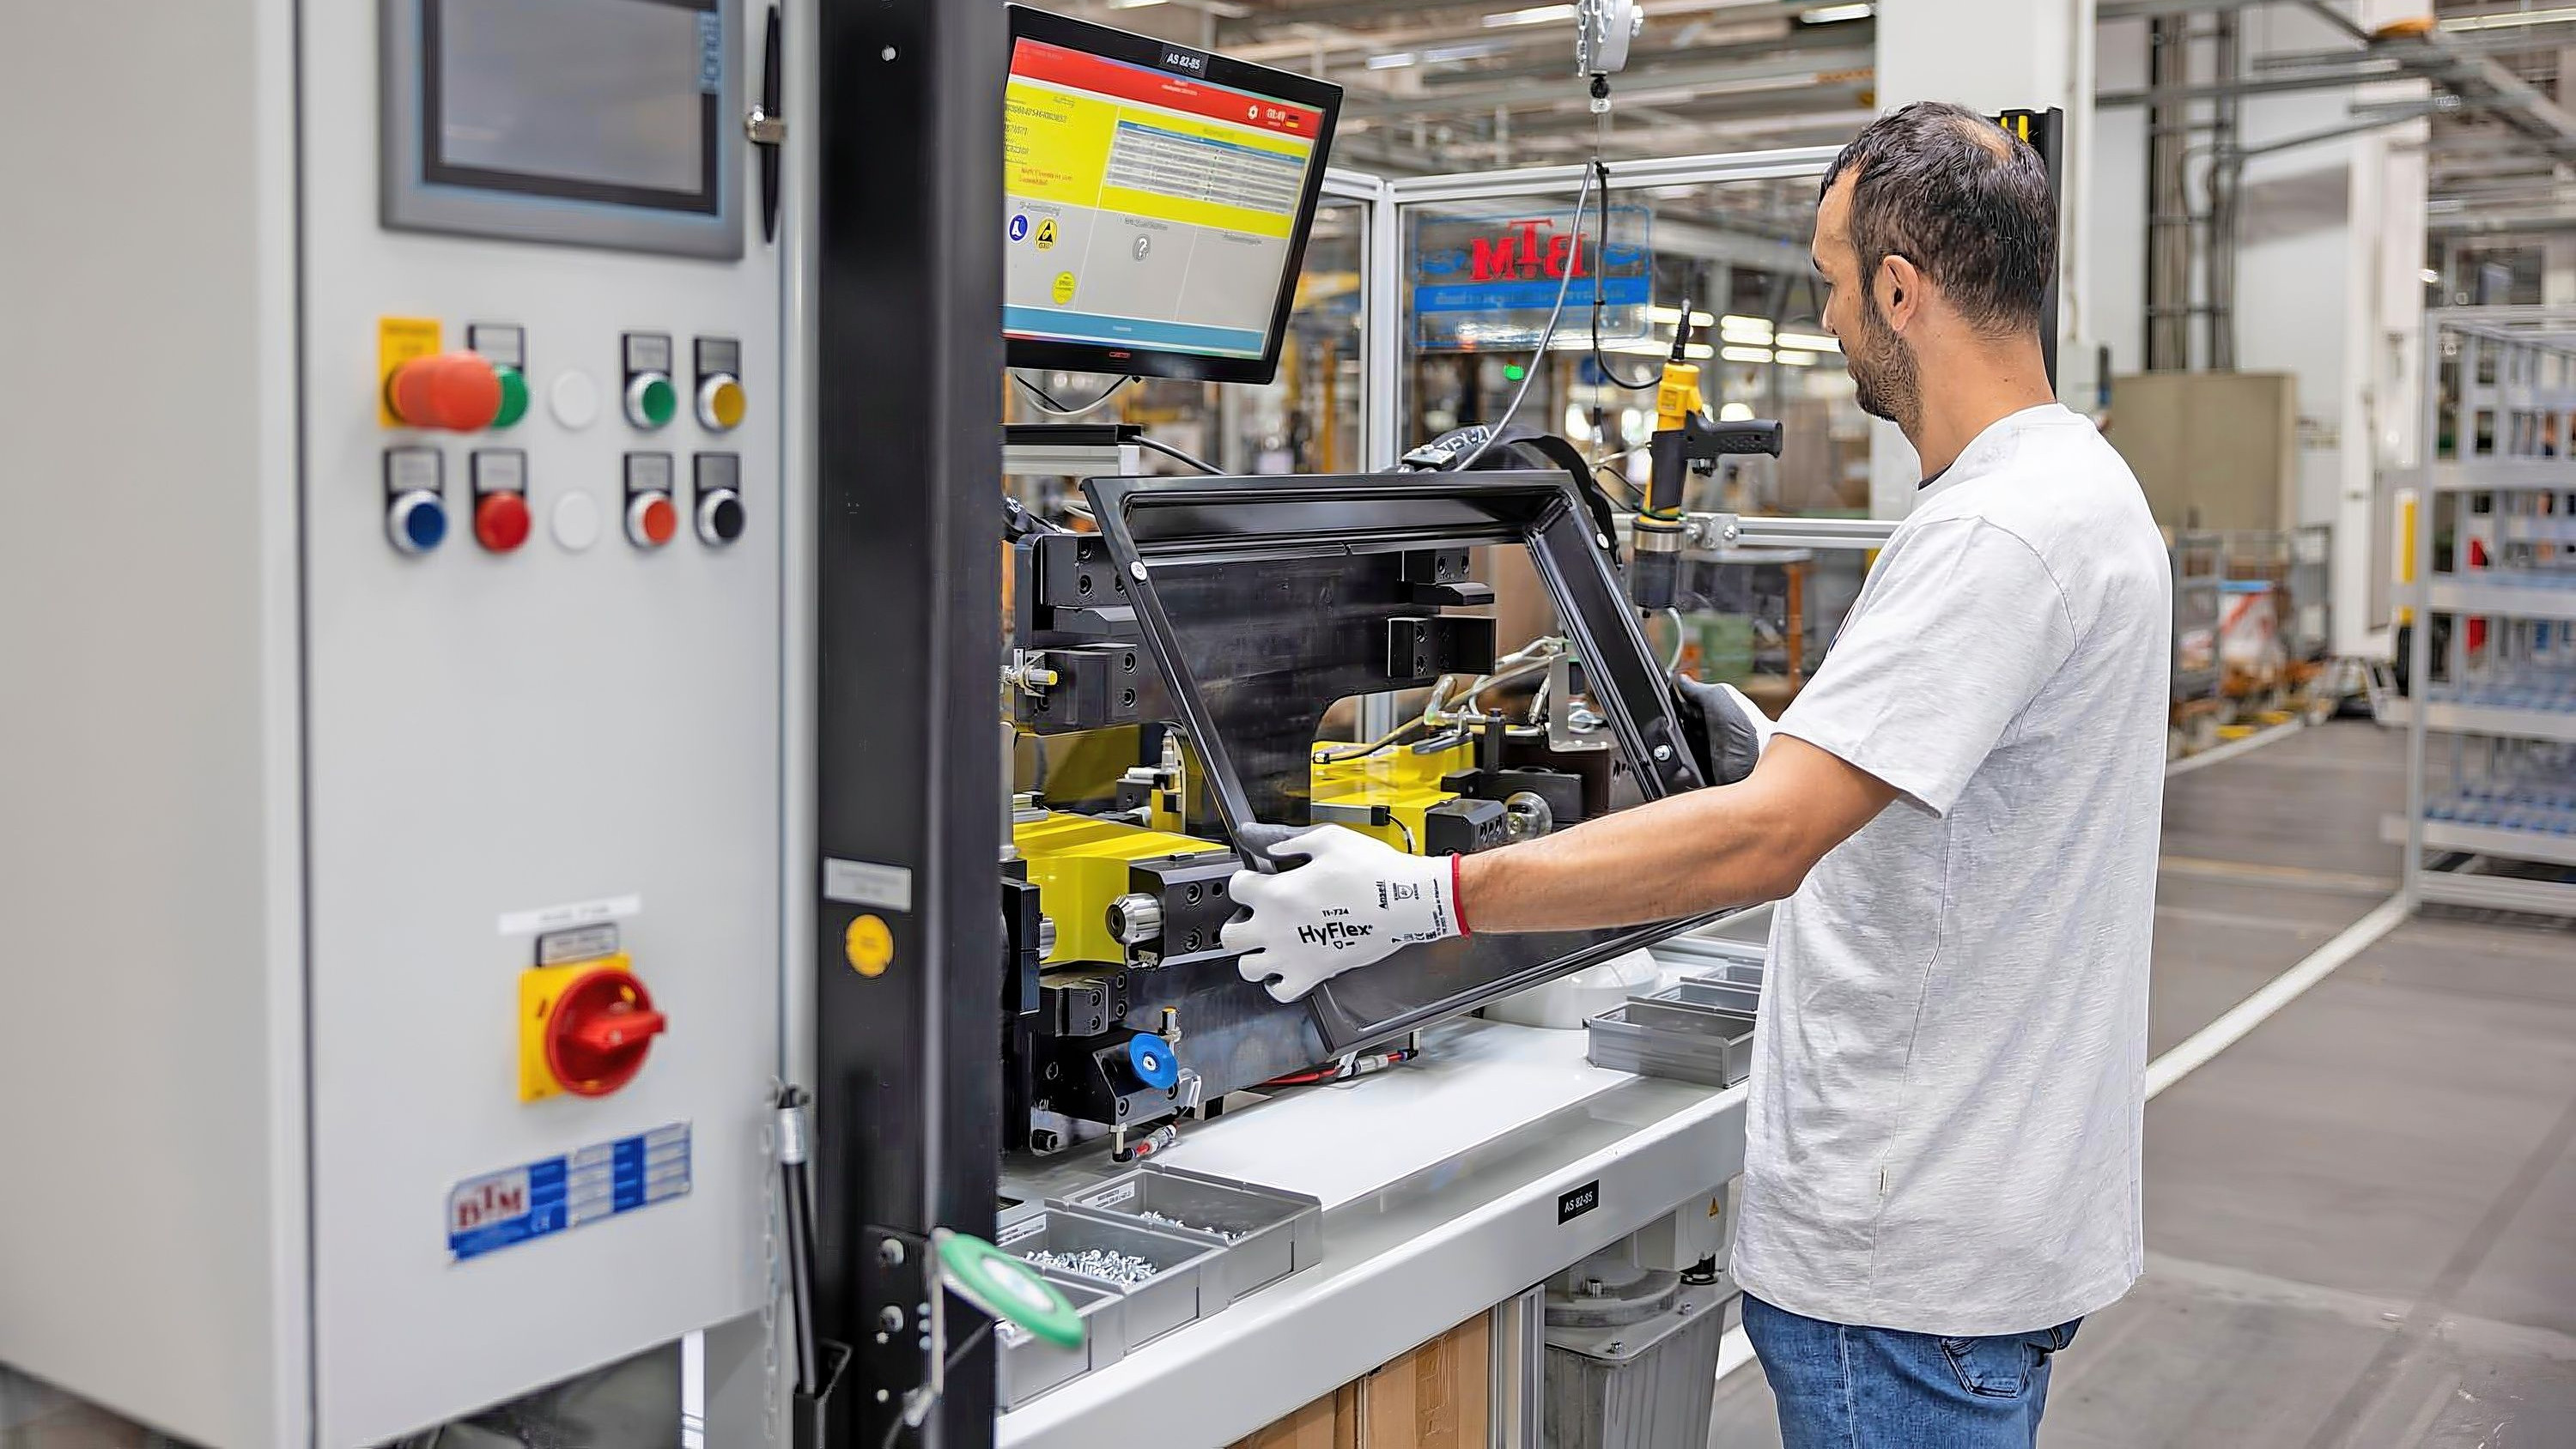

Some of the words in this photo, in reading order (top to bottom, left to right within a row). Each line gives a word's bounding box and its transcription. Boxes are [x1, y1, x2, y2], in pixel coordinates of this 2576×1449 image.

[1167, 52, 1180, 64] AS
[1297, 921, 1371, 946] HyFlex
[1564, 1199, 1575, 1213] AS
